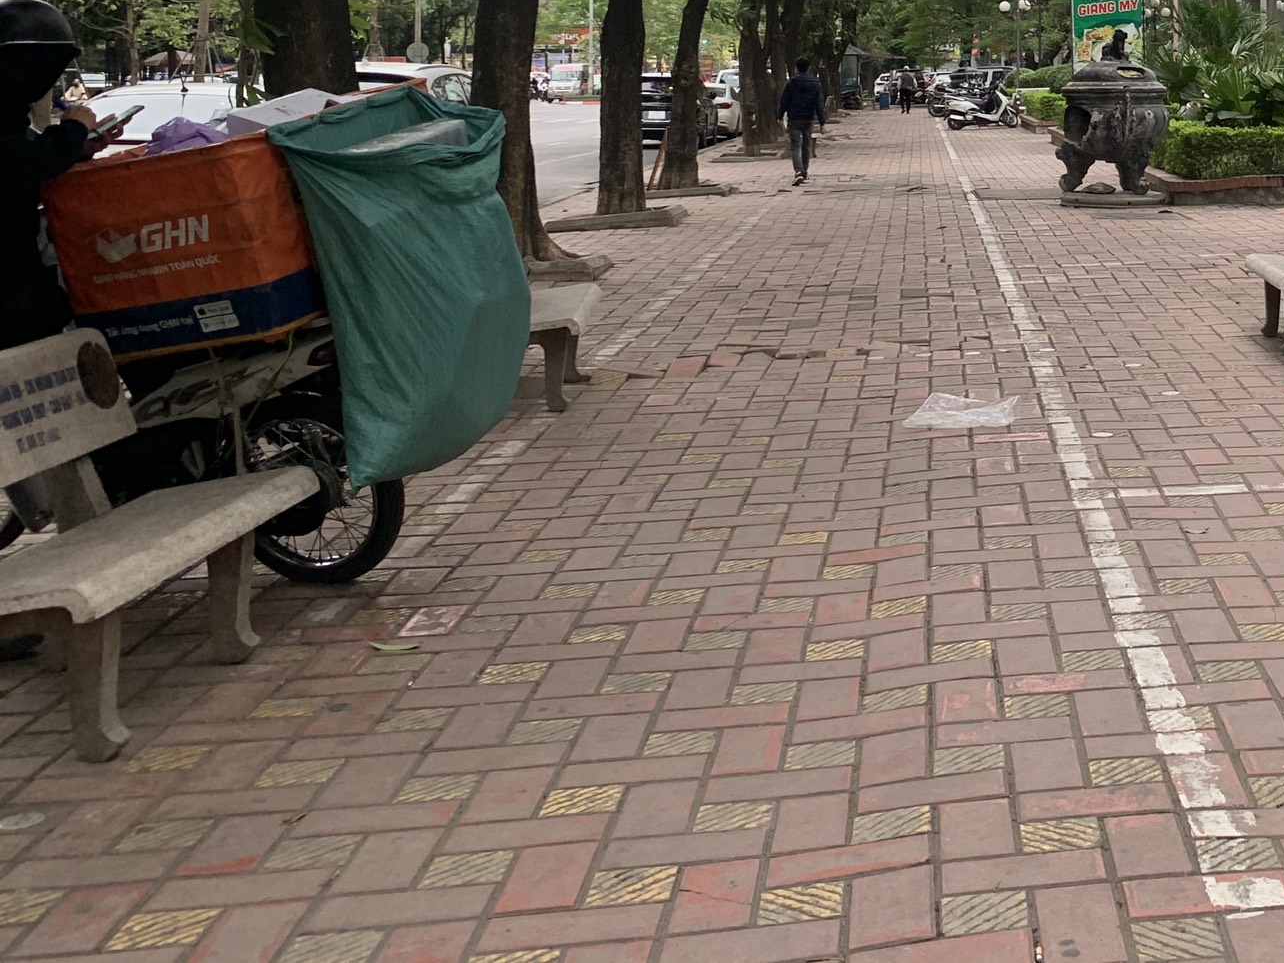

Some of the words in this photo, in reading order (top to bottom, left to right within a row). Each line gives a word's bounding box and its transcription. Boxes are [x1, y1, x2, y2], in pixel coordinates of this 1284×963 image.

[1078, 2, 1116, 17] GIANG
[140, 214, 209, 253] GHN
[169, 260, 195, 272] TOÀN
[195, 254, 221, 268] QUỐC
